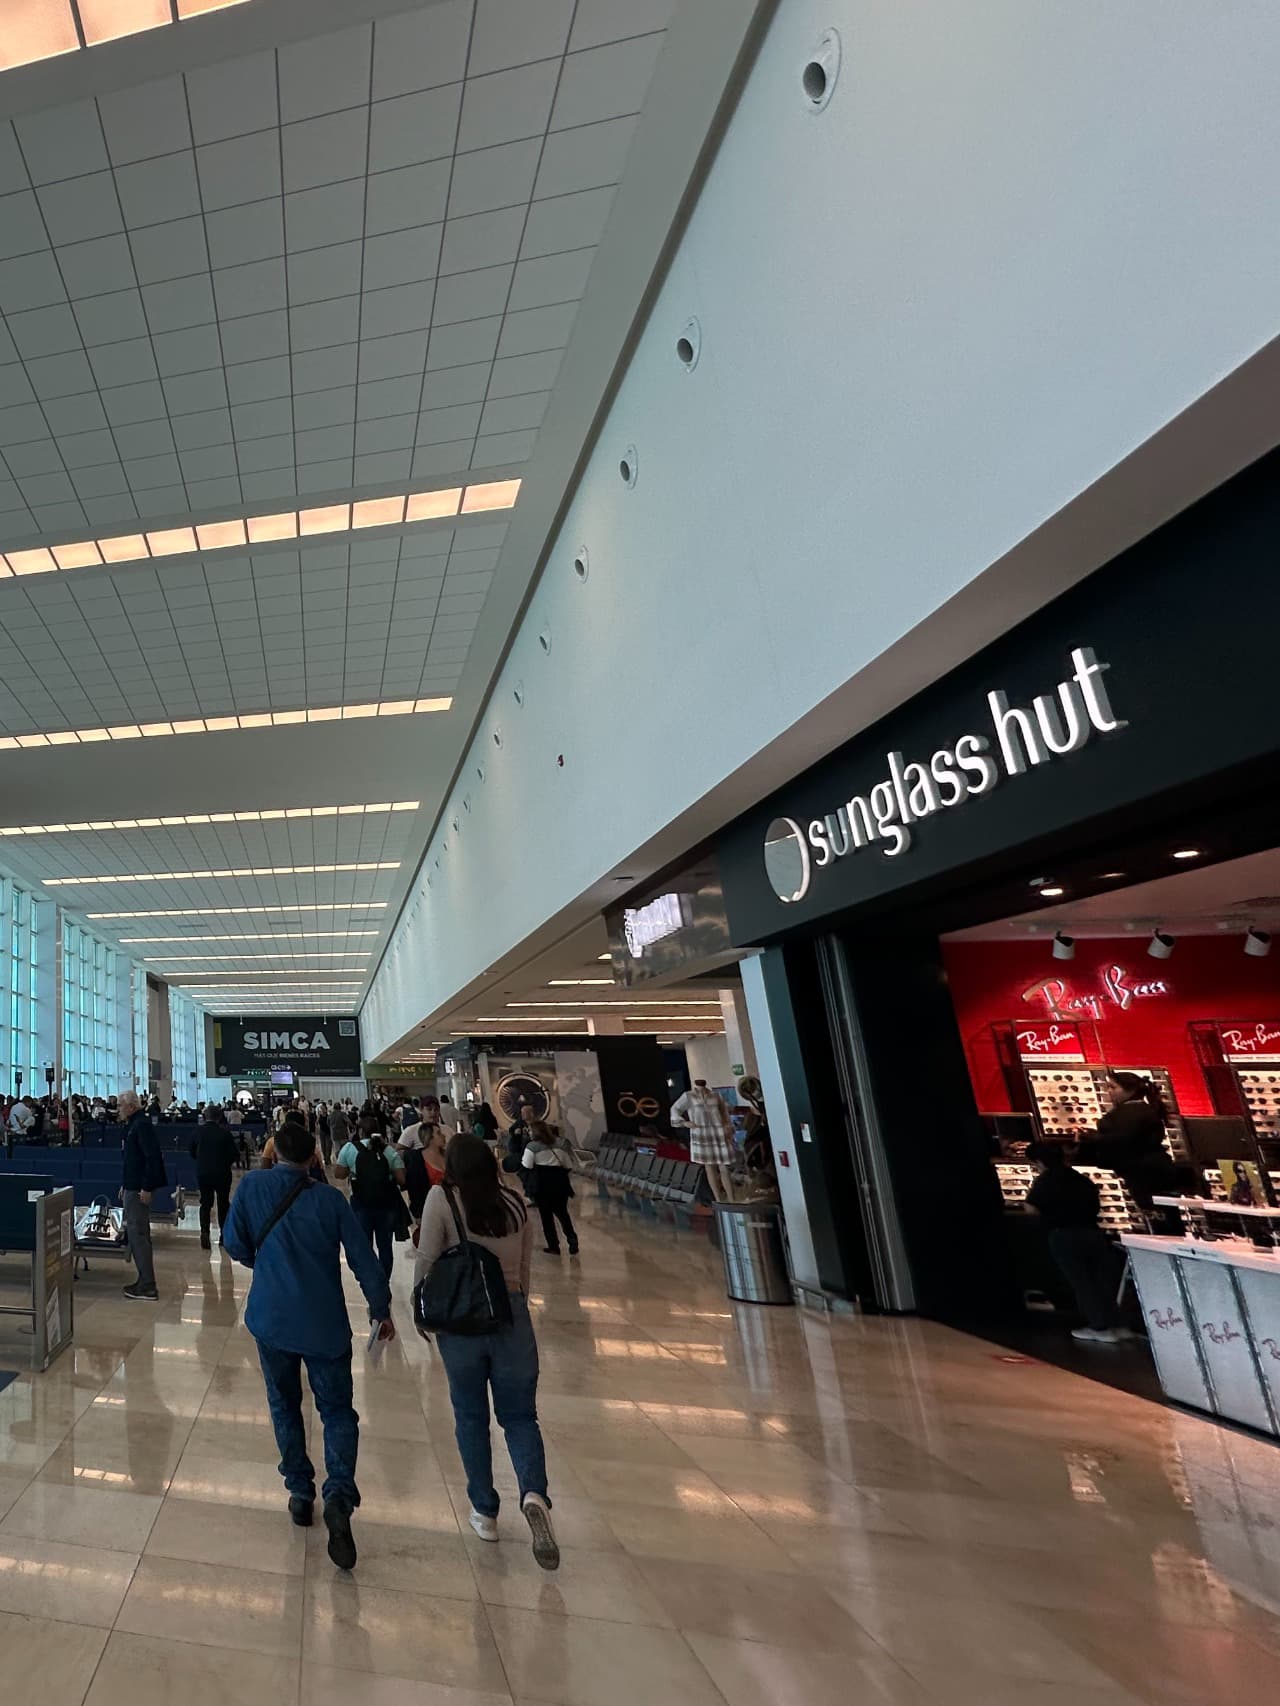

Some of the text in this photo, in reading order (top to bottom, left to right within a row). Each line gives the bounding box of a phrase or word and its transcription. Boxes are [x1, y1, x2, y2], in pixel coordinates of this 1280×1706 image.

[808, 647, 1127, 857] sunglass hut
[1022, 964, 1167, 1021] Ray-Ban
[243, 1031, 330, 1050] SIMCA
[1016, 1024, 1075, 1051] Ray-Ban
